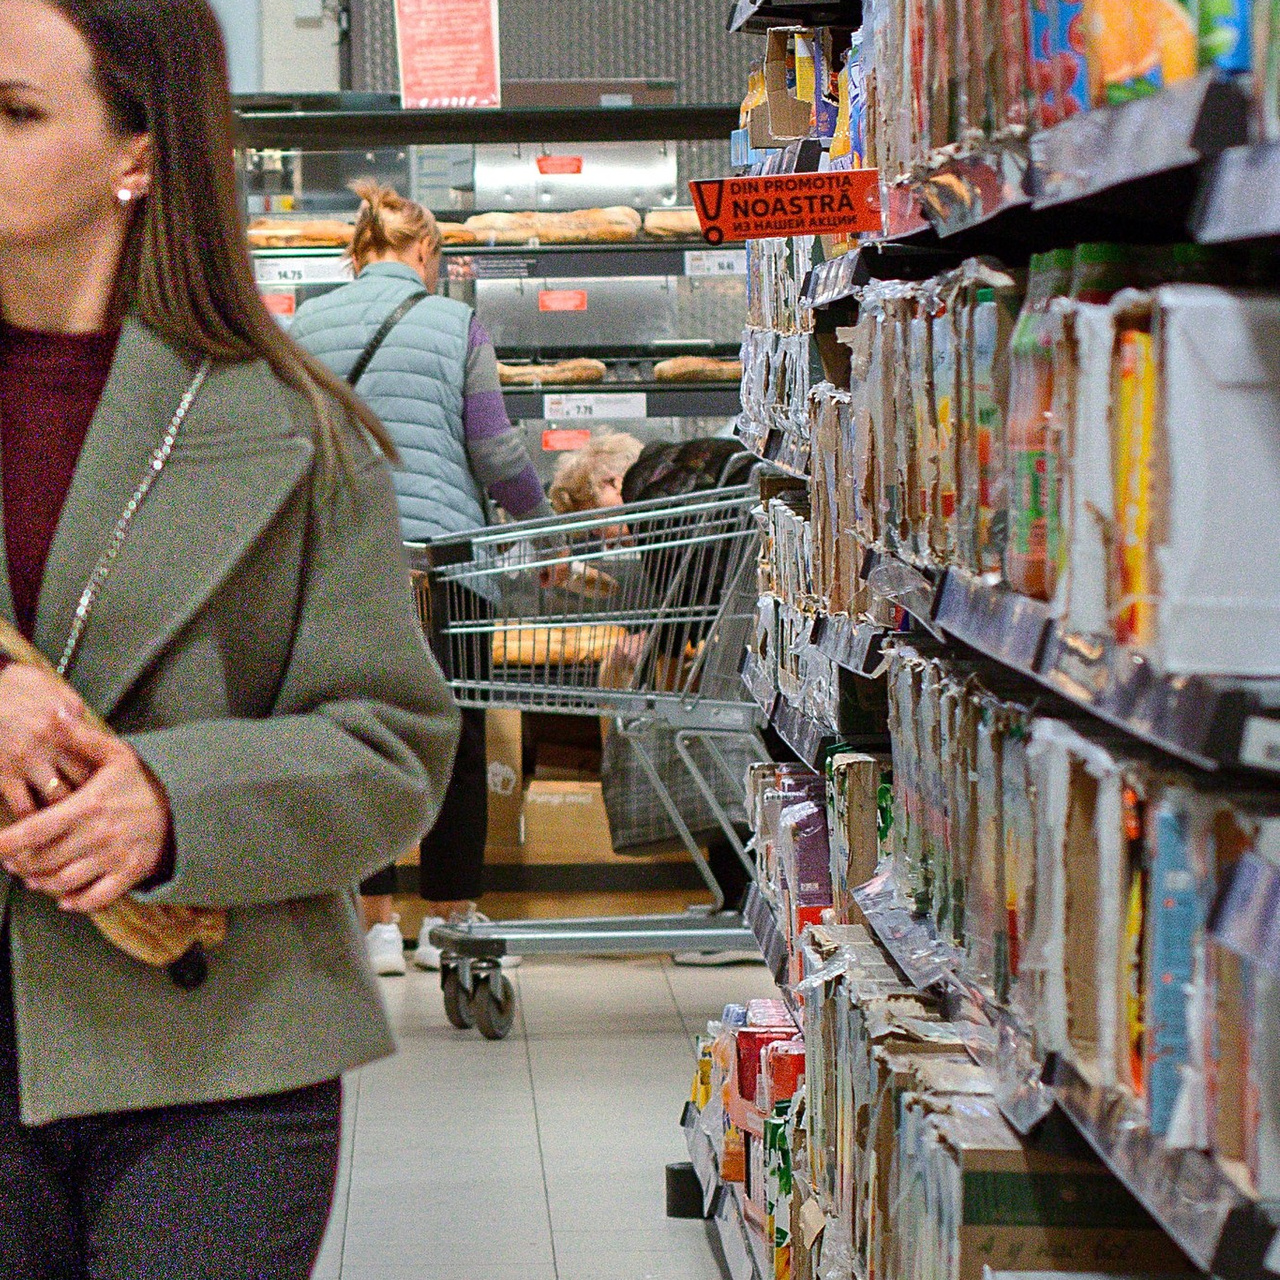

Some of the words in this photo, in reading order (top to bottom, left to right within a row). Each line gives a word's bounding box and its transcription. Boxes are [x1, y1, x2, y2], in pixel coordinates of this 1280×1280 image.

[730, 181, 759, 196] DIN
[733, 190, 855, 218] NOASTRĂ
[733, 221, 751, 233] ИЗ
[754, 217, 806, 232] НАШЕЙ
